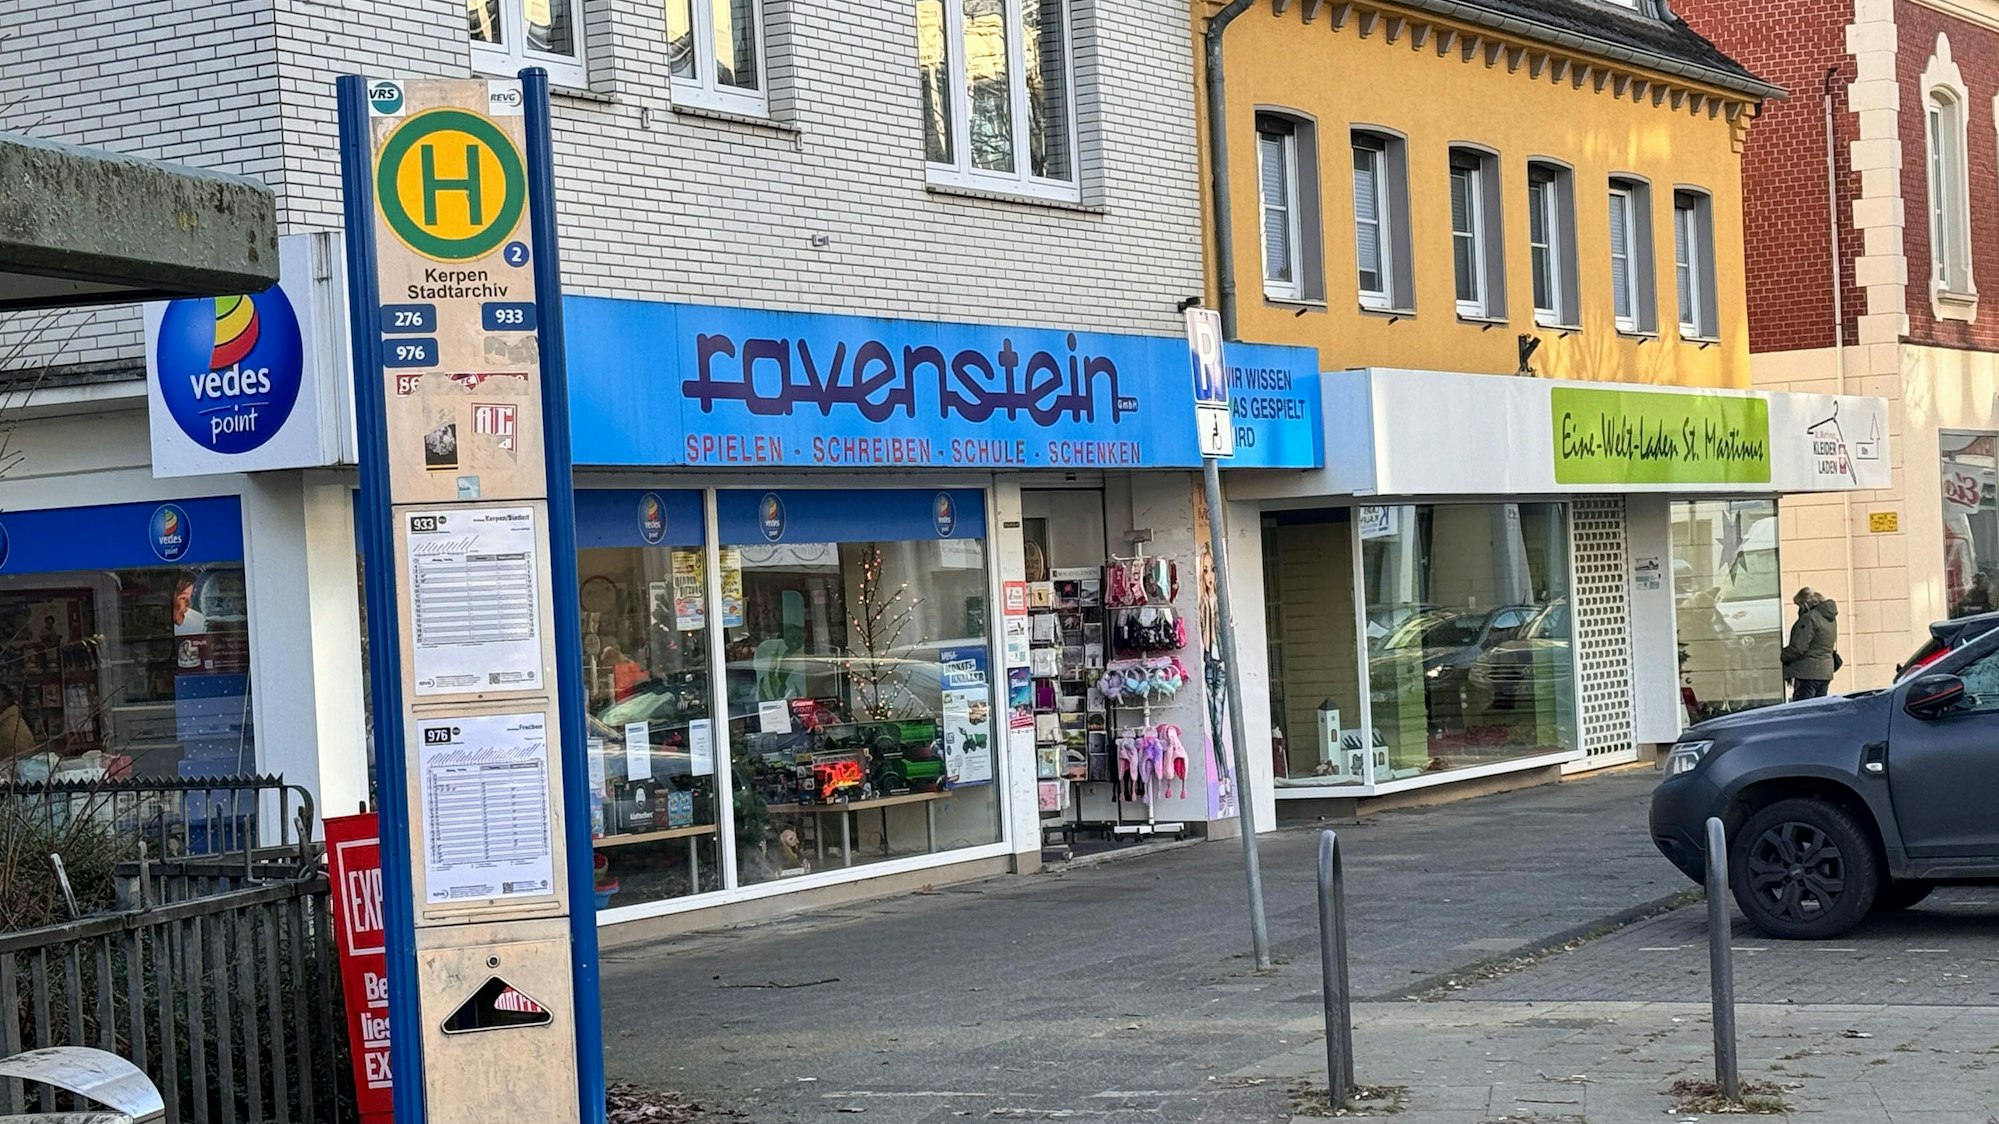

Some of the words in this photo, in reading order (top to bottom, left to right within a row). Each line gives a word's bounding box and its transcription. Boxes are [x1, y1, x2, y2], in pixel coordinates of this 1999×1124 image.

[369, 88, 395, 99] VRS
[490, 93, 516, 102] REVG
[421, 144, 483, 226] H
[511, 247, 522, 262] 2
[425, 268, 488, 286] Kerpen
[407, 284, 508, 300] Stadtarchiv
[395, 312, 423, 326] 276
[495, 309, 524, 324] 933
[396, 346, 425, 360] 976
[1197, 322, 1217, 390] P
[190, 363, 271, 400] vedes
[682, 333, 1121, 427] ravenstein
[1245, 369, 1292, 391] WISSEN
[1233, 397, 1248, 418] AS
[1251, 399, 1305, 420] GESPIELT
[210, 404, 258, 444] point
[1235, 427, 1255, 447] IRD
[1562, 411, 1679, 461] Eine-Welt-Laden
[1682, 416, 1700, 462] St.
[1705, 417, 1764, 462] Martinus
[687, 434, 783, 462] SPIELEN
[813, 436, 931, 463] SCHREIBEN
[951, 439, 1025, 464] SCHULE
[1049, 441, 1140, 464] SCHENKEN
[1812, 440, 1837, 456] KLEIDER
[1818, 460, 1837, 474] LADEN
[413, 518, 434, 530] 933
[159, 533, 182, 545] vedes
[427, 729, 448, 742] 976
